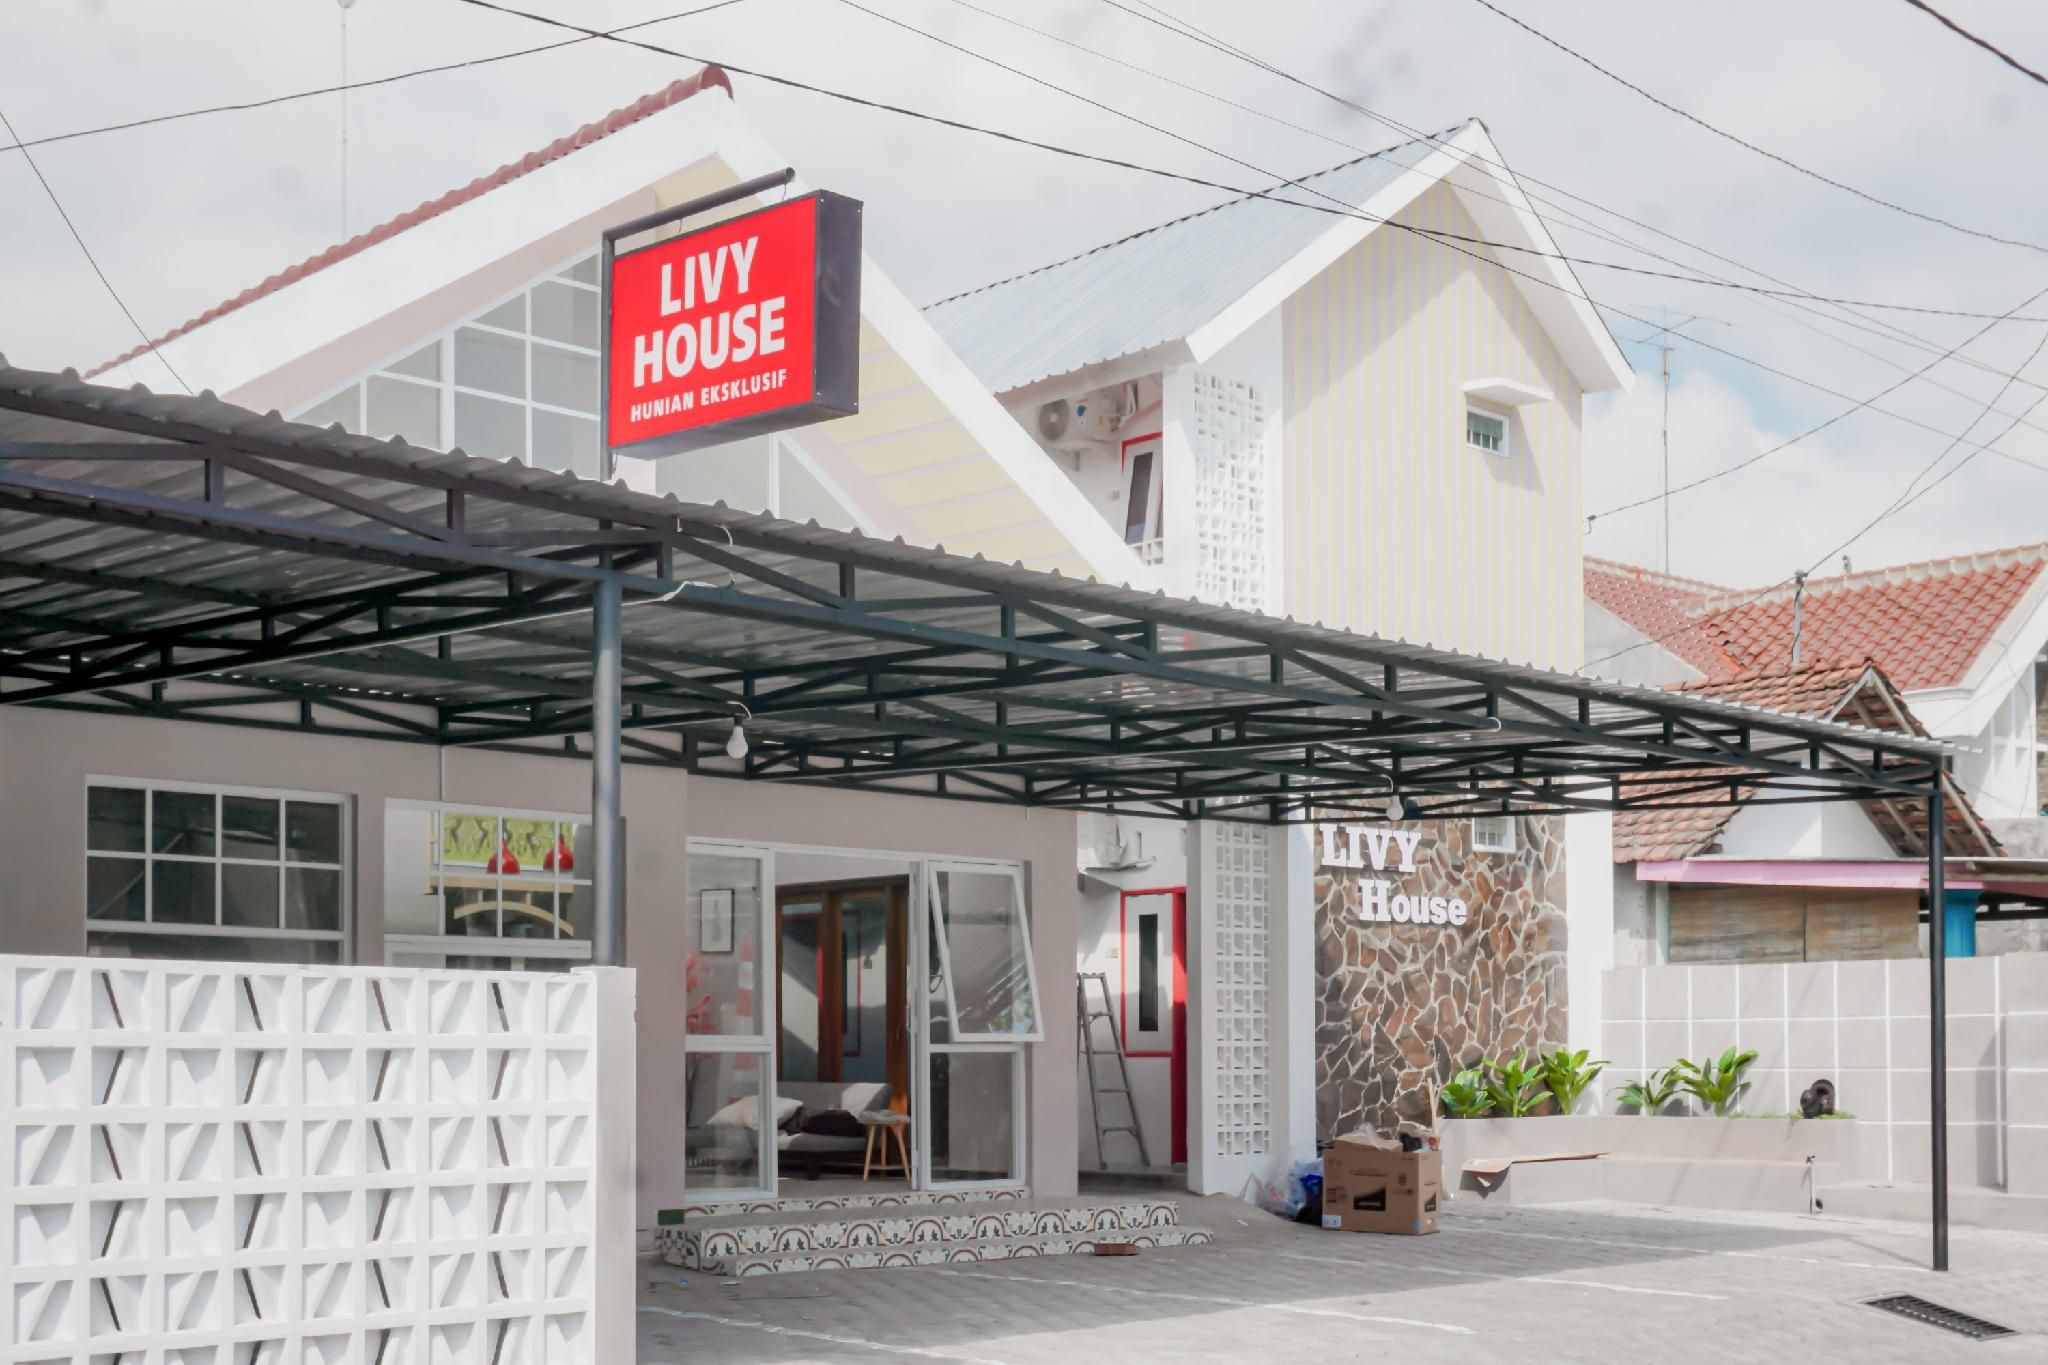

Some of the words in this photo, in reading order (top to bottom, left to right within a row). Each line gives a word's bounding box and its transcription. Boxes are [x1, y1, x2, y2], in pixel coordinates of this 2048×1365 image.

[661, 236, 759, 316] LIVY
[633, 296, 785, 388] HOUSE
[630, 391, 694, 423] HUNIAN
[701, 368, 787, 407] EKSKLUSIF
[1319, 823, 1422, 873] LIVY
[1358, 879, 1467, 926] House
